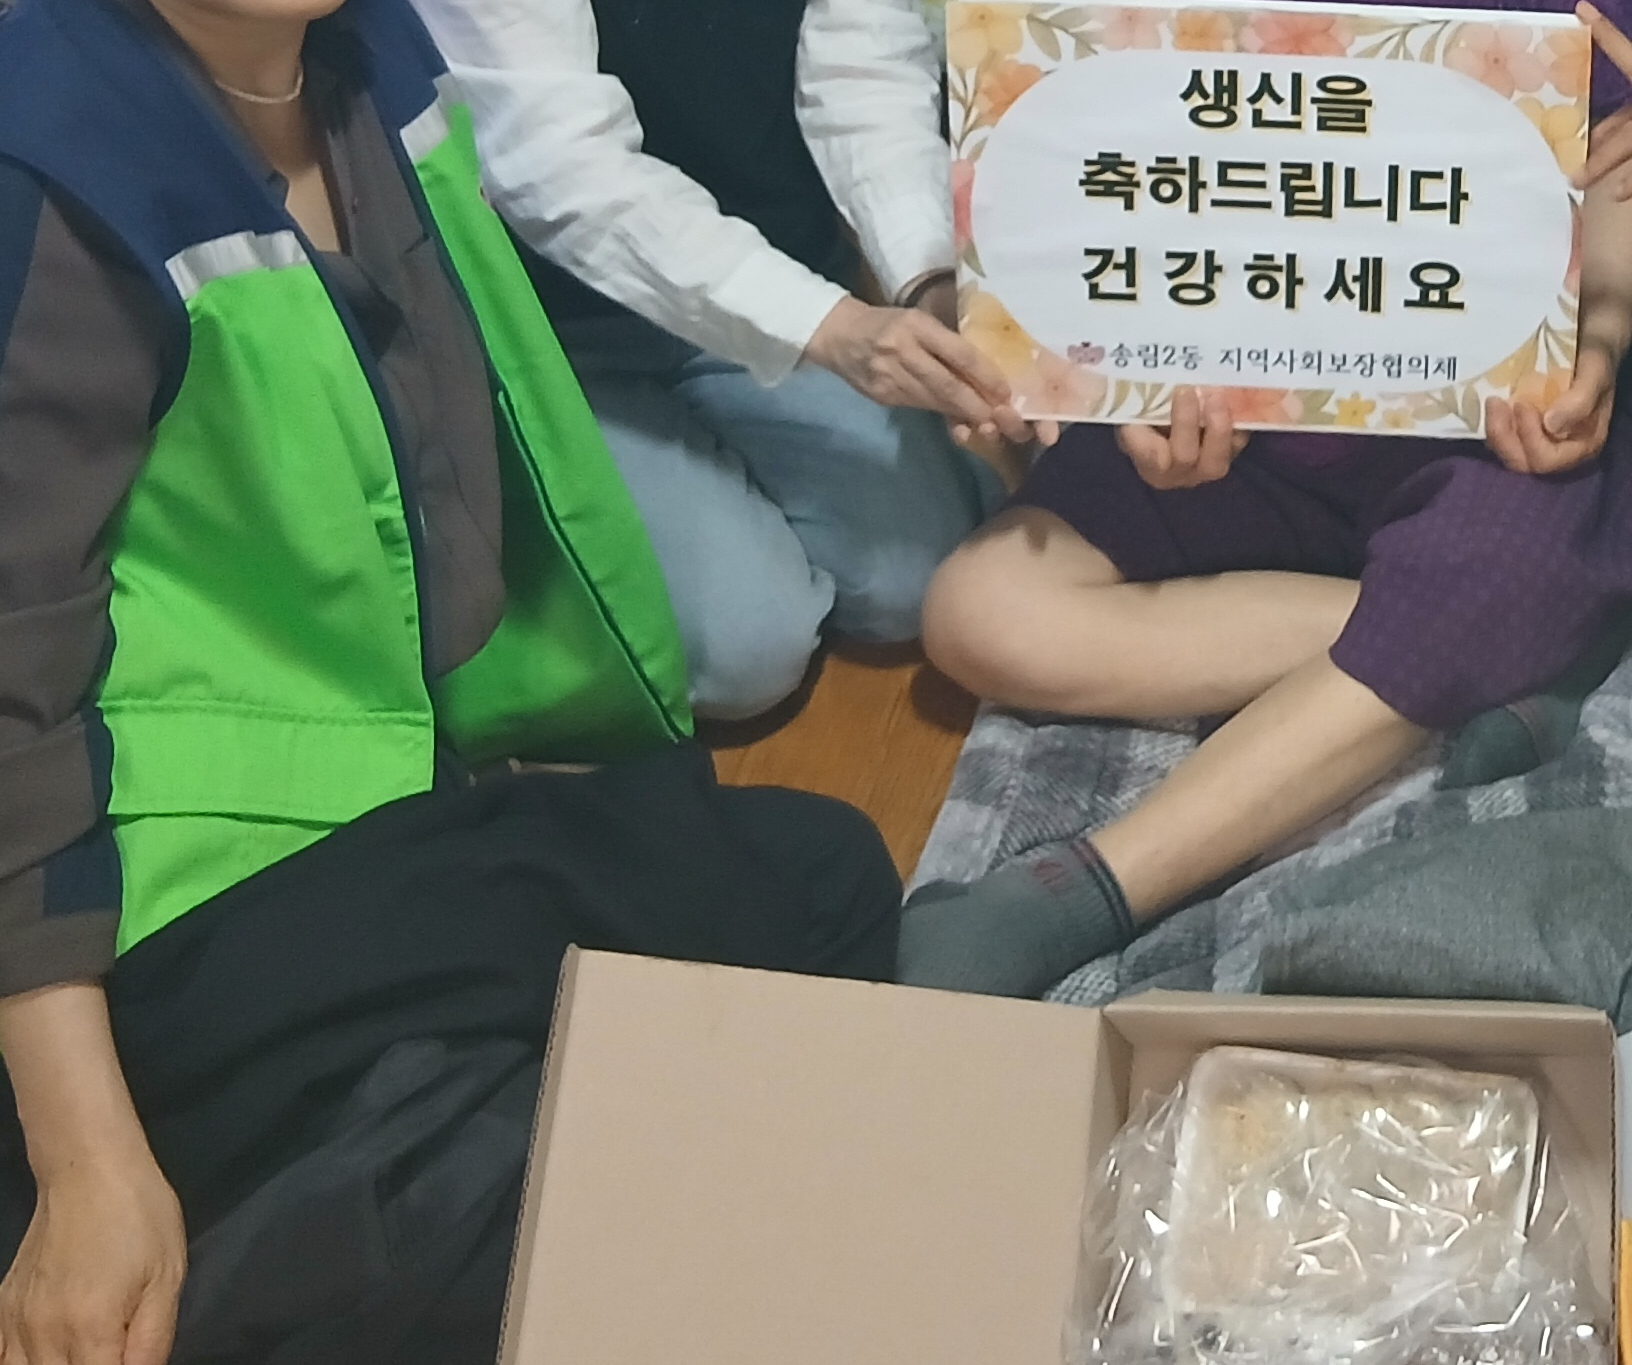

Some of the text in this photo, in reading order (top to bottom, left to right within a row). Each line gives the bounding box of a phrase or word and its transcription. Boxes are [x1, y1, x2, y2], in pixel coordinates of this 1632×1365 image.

[1180, 67, 1374, 133] 생신을
[1077, 152, 1470, 225] 축하드립니다
[1109, 342, 1458, 381] 송림2동 지역사회보장협의체
